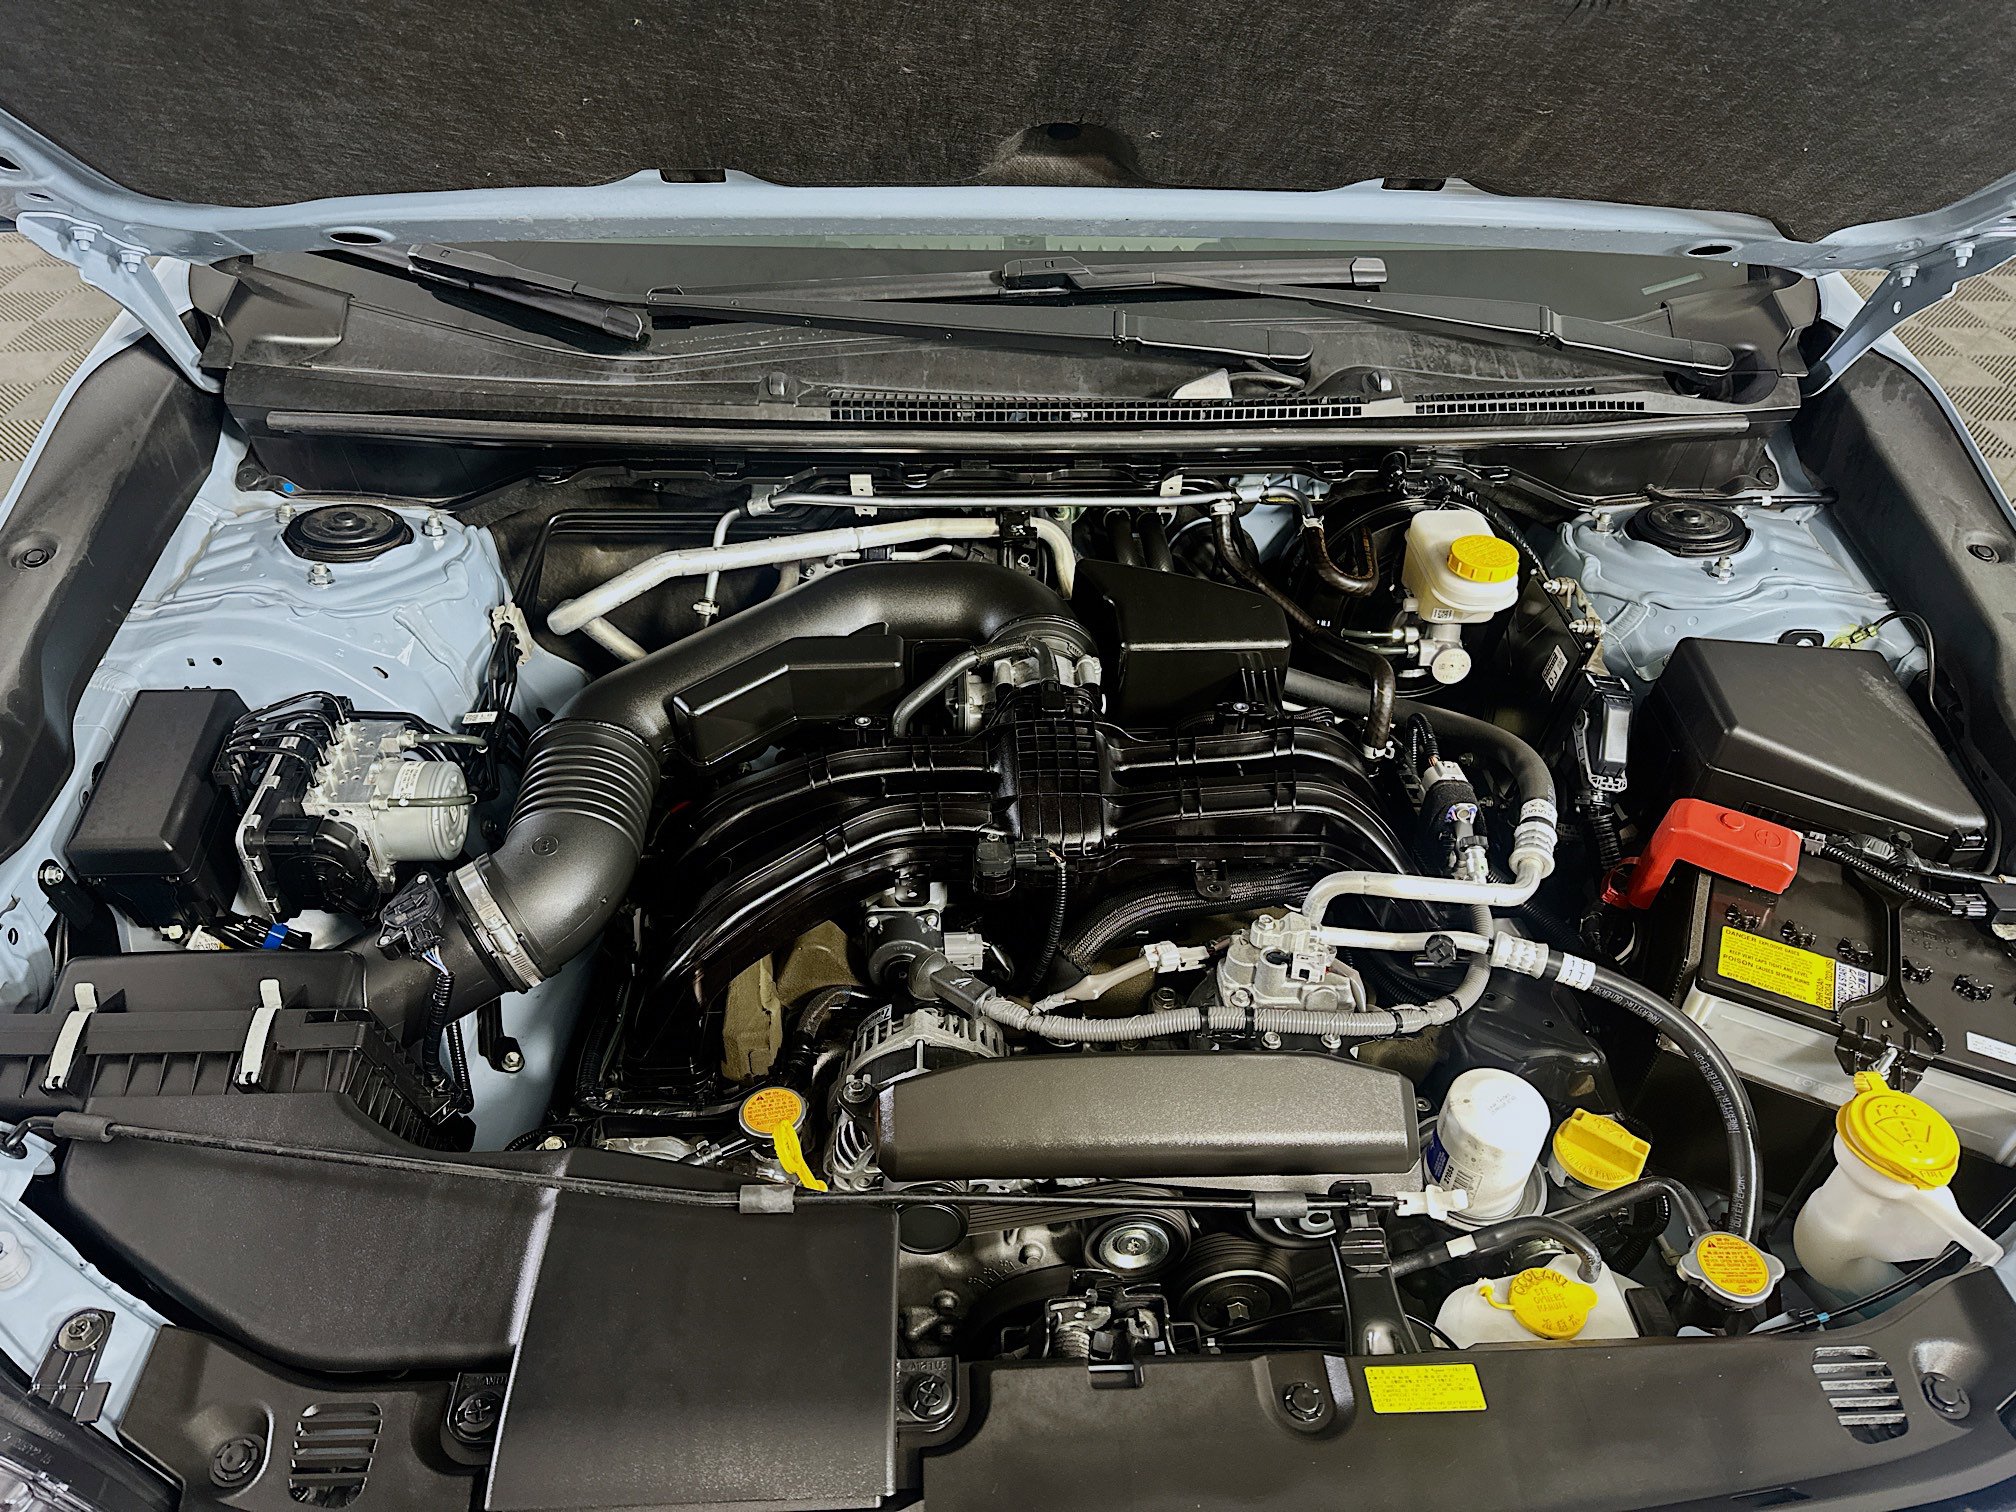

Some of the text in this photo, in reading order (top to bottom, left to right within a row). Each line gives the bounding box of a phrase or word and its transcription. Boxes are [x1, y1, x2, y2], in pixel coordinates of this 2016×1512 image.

[1725, 929, 1757, 943] DANGER
[1722, 953, 1754, 968] POISON
[1755, 964, 1774, 975] CAUSES
[1754, 957, 1768, 965] CAPS
[1768, 961, 1783, 970] TIGHT
[1783, 966, 1794, 974] AND
[1794, 969, 1808, 978] LEVEL
[1513, 1269, 1569, 1296] COOLANT
